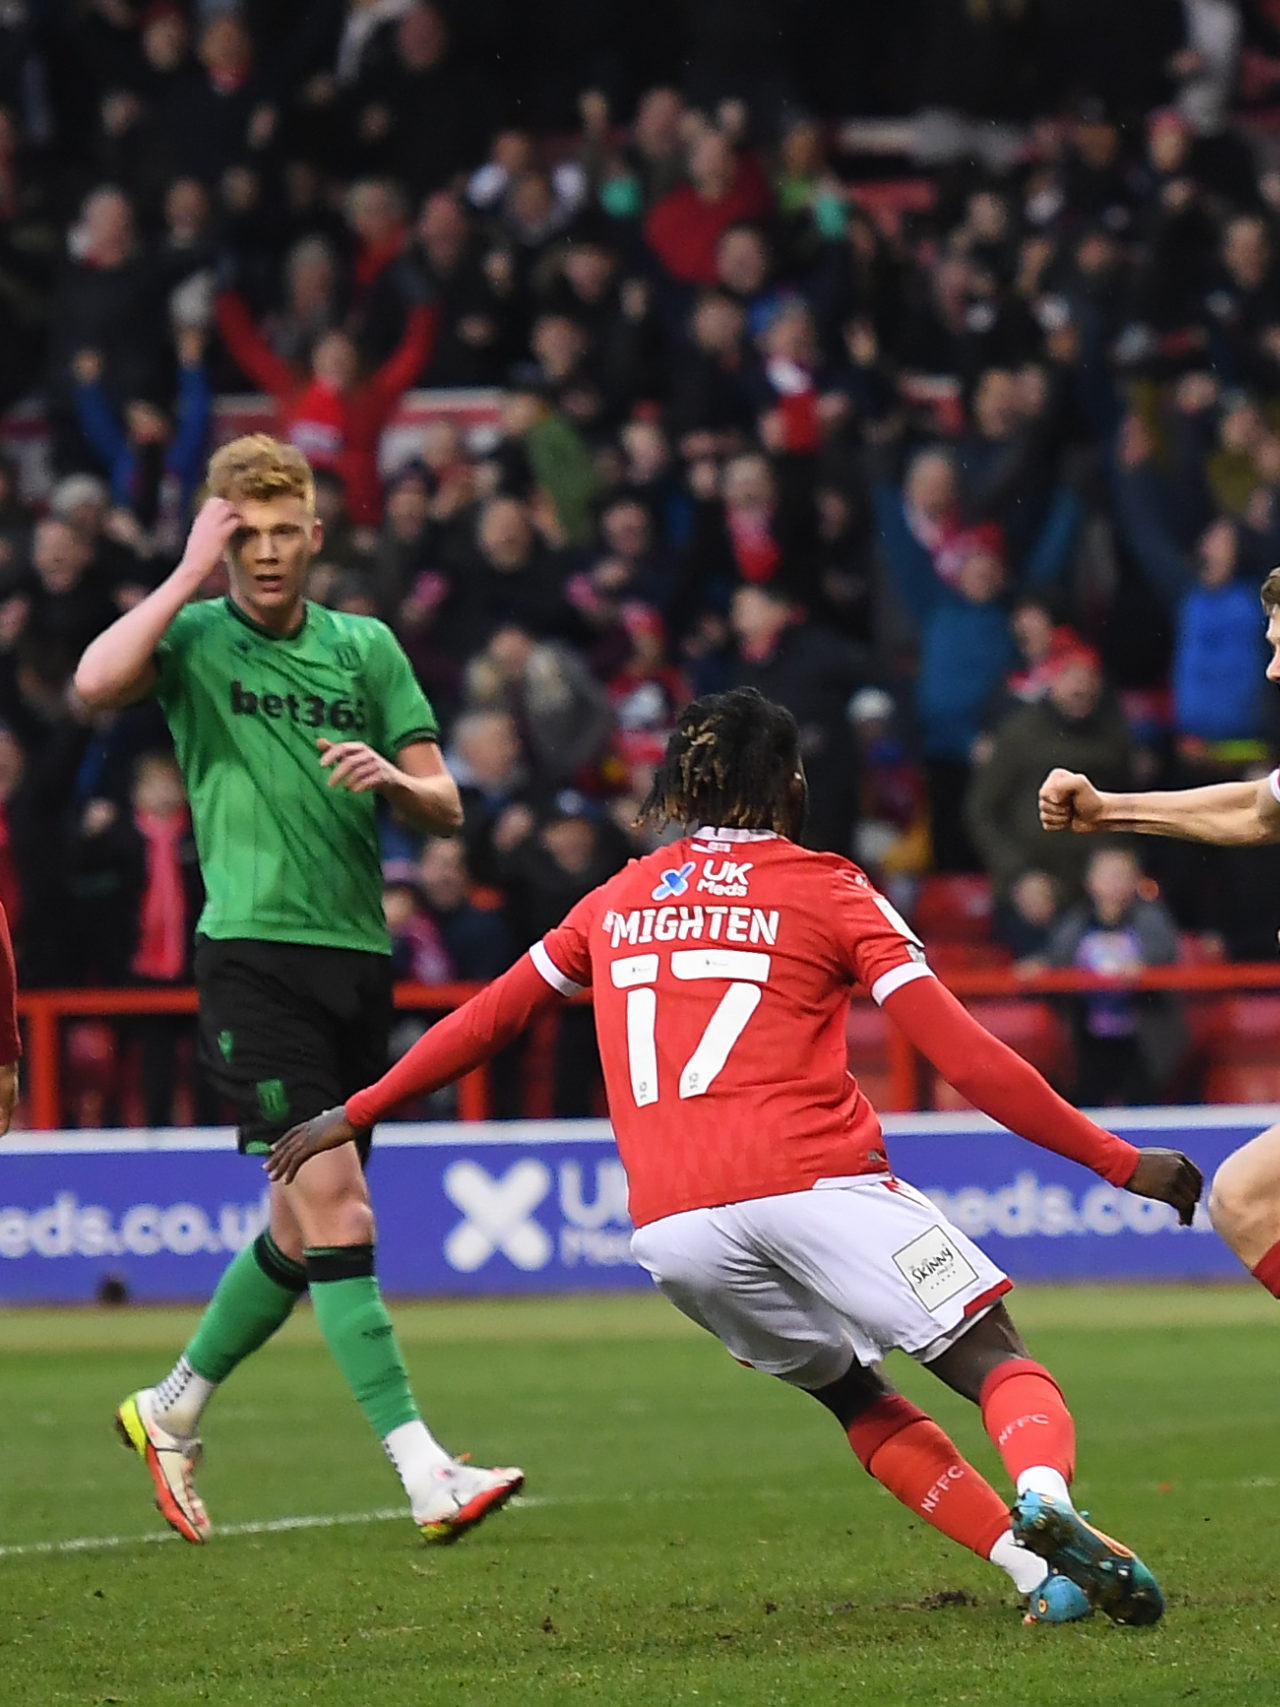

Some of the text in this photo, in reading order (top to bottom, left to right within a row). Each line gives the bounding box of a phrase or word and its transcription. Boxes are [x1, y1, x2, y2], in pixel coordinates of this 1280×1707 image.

[696, 878, 748, 897] Meds
[702, 859, 754, 886] UK
[610, 905, 780, 948] MIGHTEN
[610, 948, 772, 1109] 17
[998, 1413, 1049, 1446] NFFC
[920, 1465, 965, 1514] NFFC
